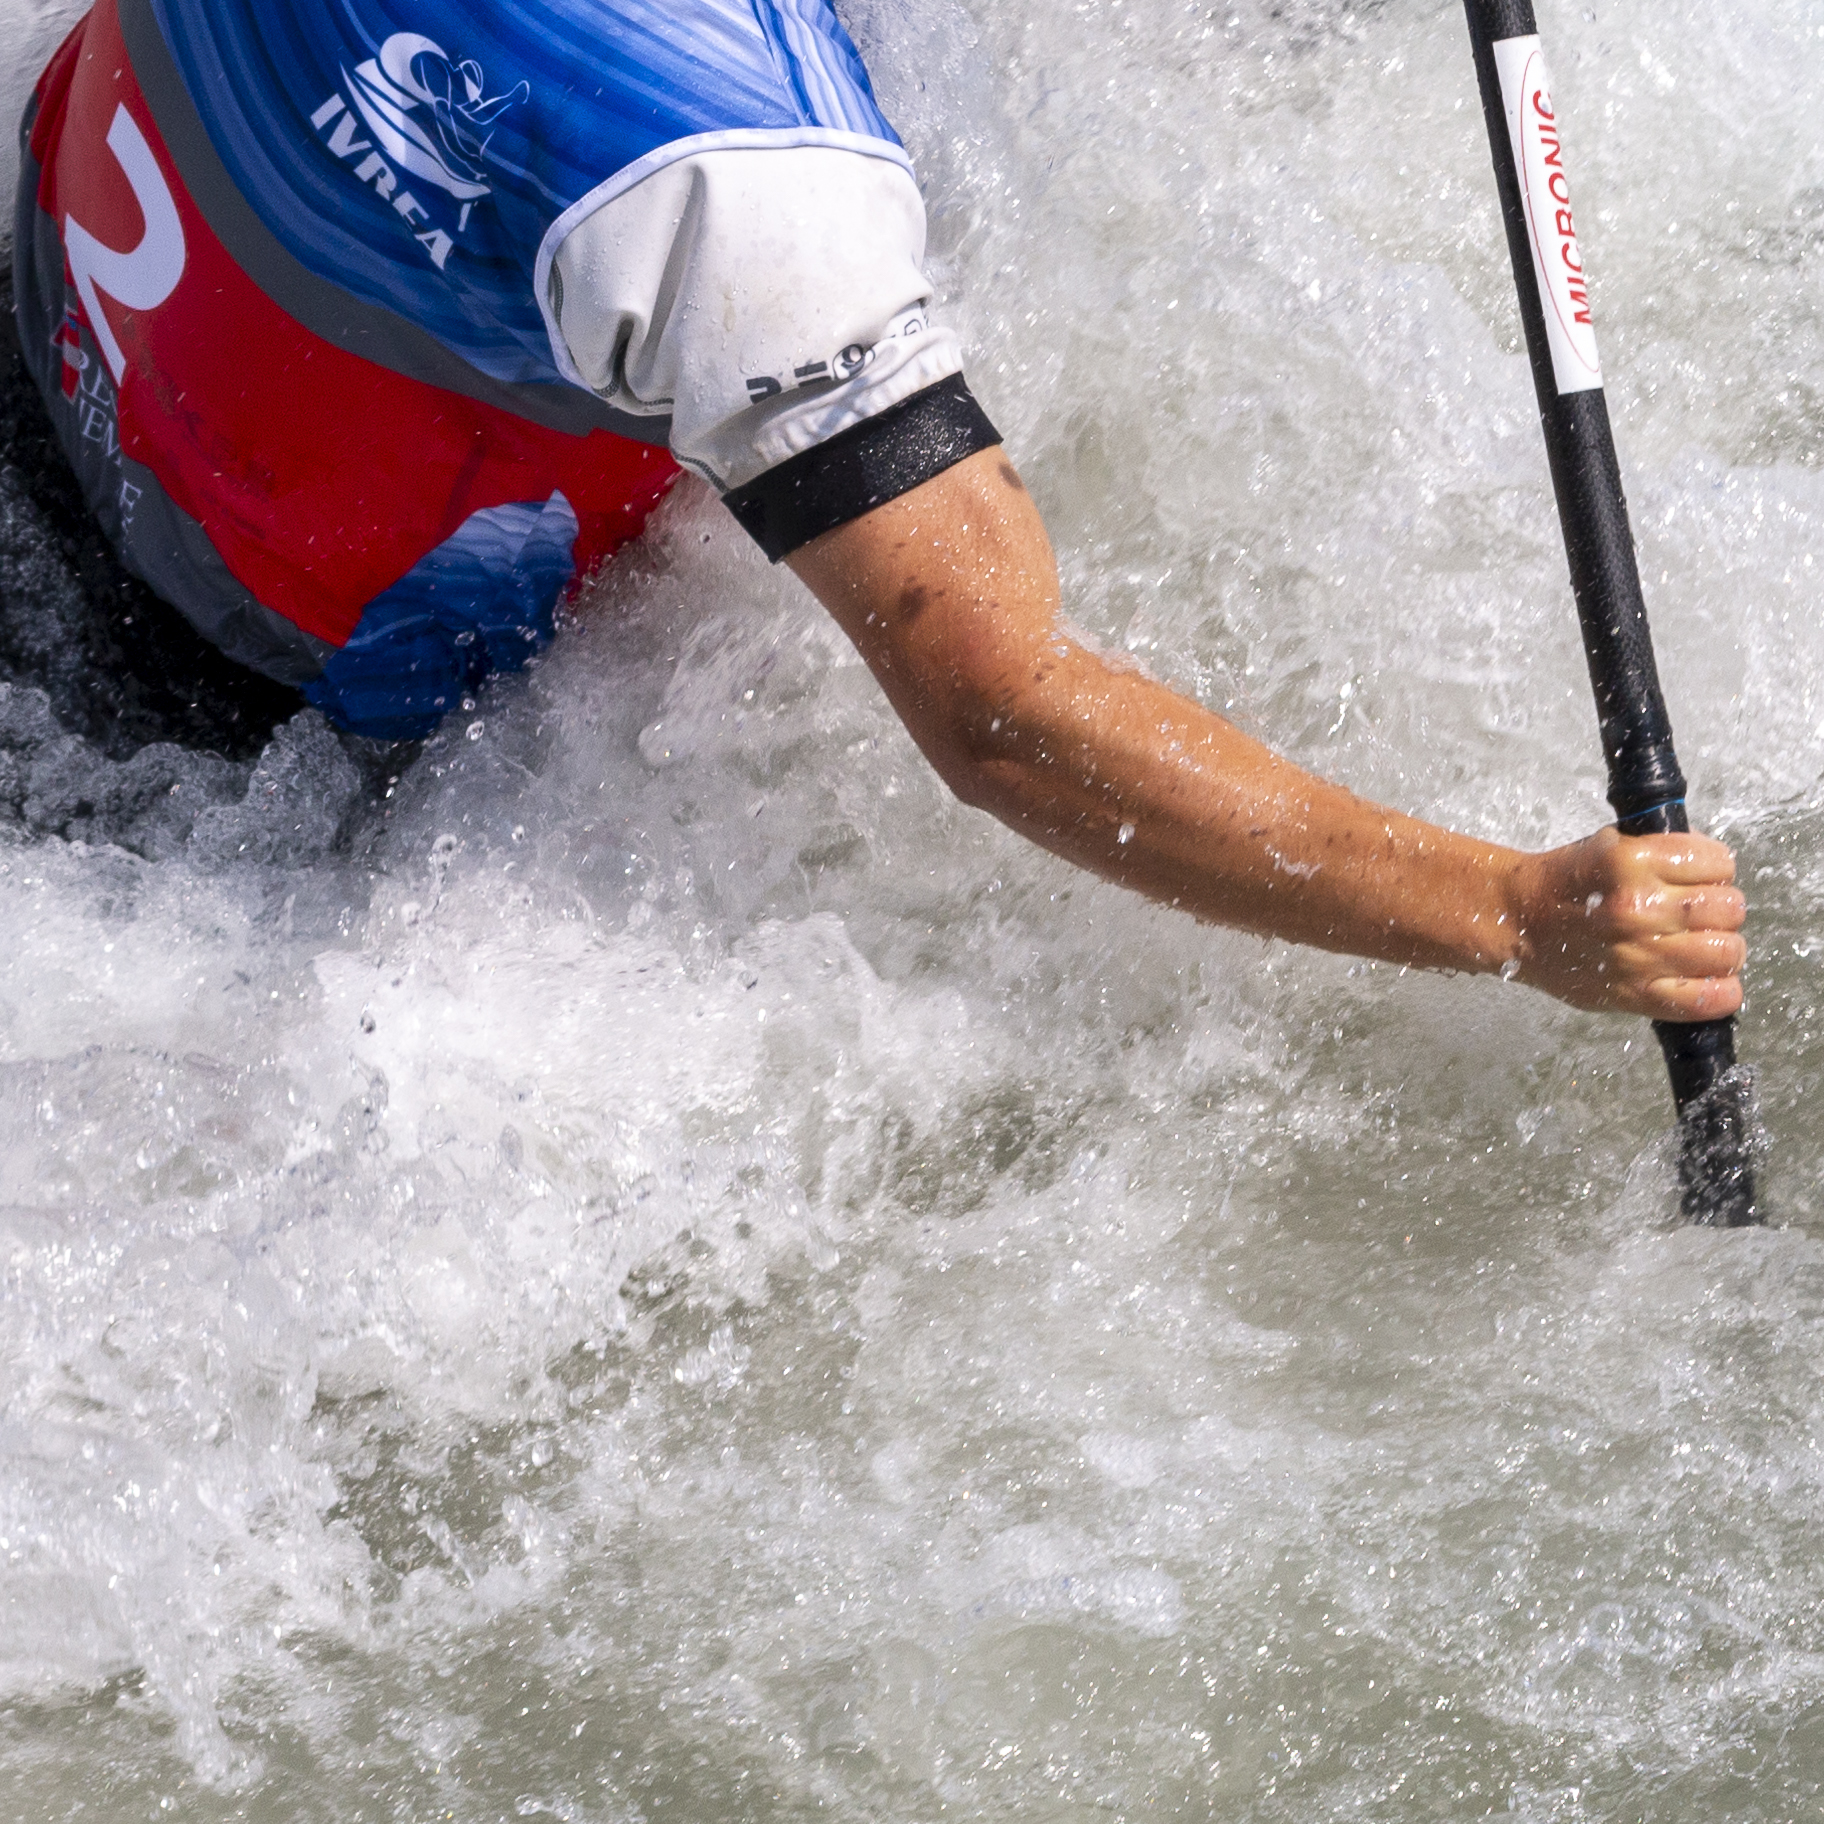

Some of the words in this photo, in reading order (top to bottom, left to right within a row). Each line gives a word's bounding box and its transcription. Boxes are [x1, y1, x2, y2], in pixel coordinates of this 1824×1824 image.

[64, 101, 186, 388] 2
[310, 92, 454, 270] IVREA
[1532, 90, 1592, 325] MICRONIC
